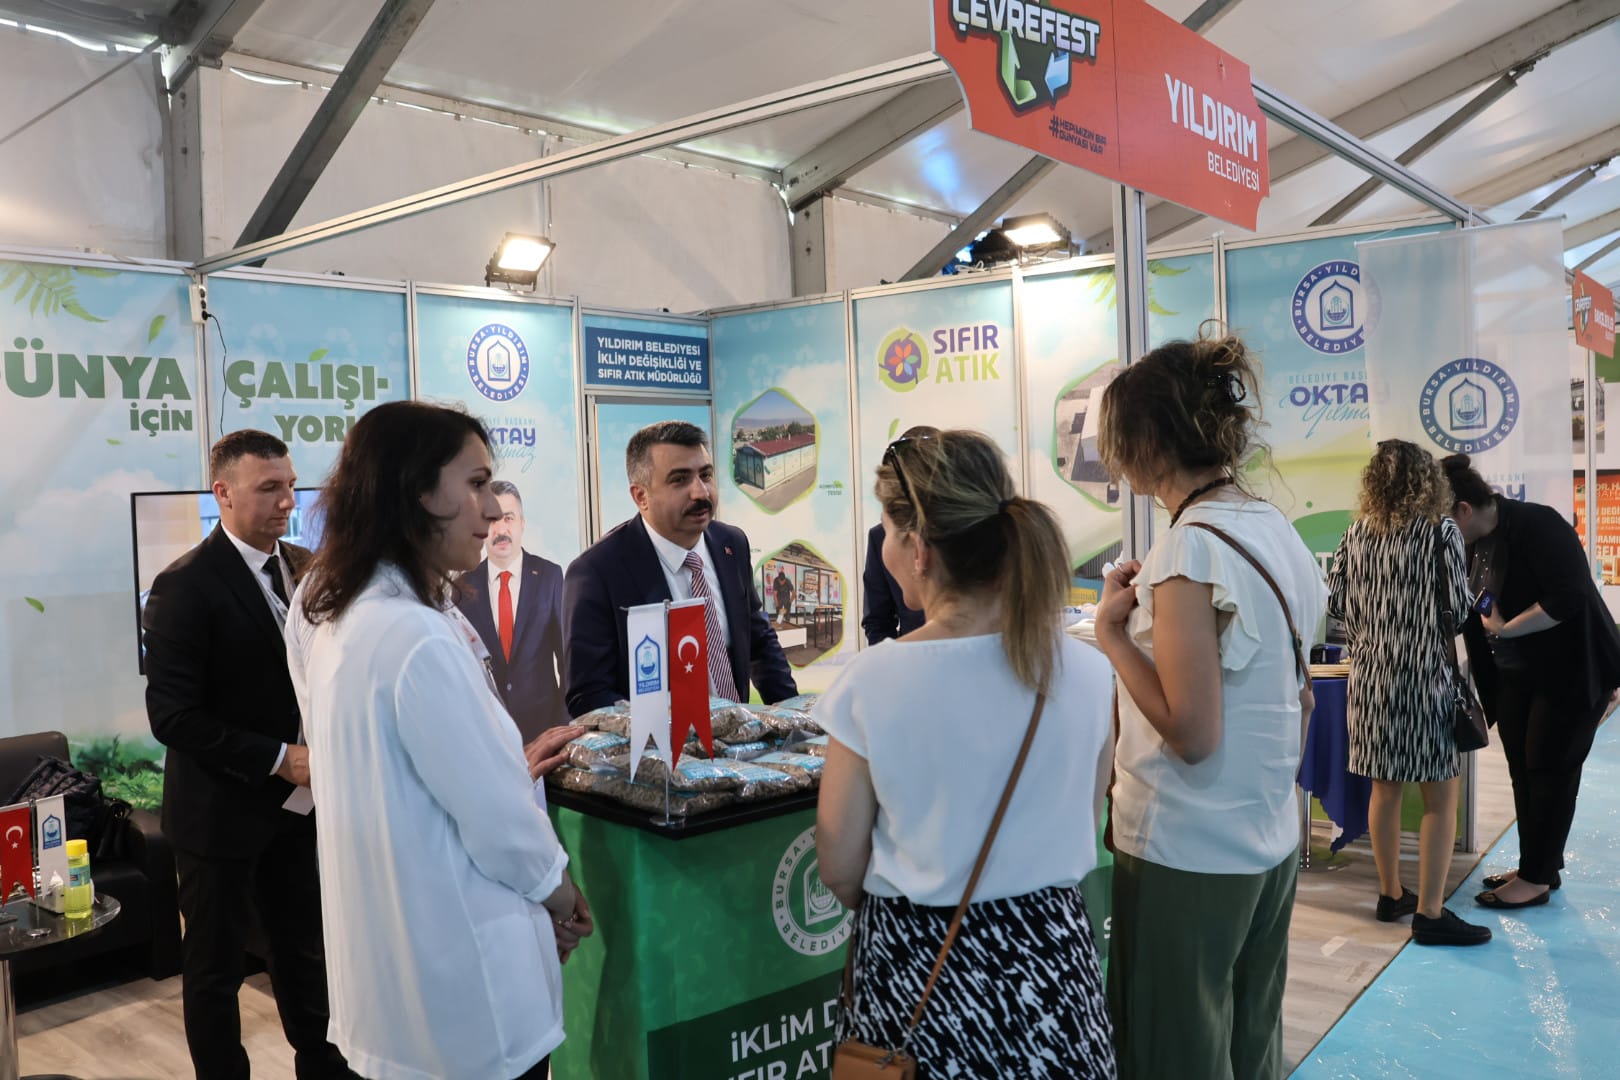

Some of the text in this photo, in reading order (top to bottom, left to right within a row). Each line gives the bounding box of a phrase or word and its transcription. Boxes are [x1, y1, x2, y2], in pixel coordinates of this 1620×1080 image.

[952, 0, 1101, 57] ÇEVREFEST
[1164, 73, 1258, 162] YILDIRIM
[1207, 150, 1260, 192] BELEDİYESİ
[1295, 264, 1359, 316] BURSA YILD
[597, 336, 701, 356] YILDIRIM BELEDİYESİ
[932, 324, 999, 355] SIFIR
[0, 337, 192, 400] ÜNYA
[597, 350, 702, 371] İKLİM DEĞİŞİKLİĞİ VE
[598, 368, 702, 385] SIFIR ATIK MÜDÜRLÜĞÜ
[935, 353, 1000, 384] ATIK
[1289, 383, 1369, 407] OKTA
[1423, 361, 1515, 415] BURSA YILDIRIM
[130, 402, 193, 437] İÇİN
[274, 415, 356, 442] YOR
[485, 427, 537, 447] KTAY
[775, 845, 802, 910] BURSA
[795, 1040, 833, 1080] AT
